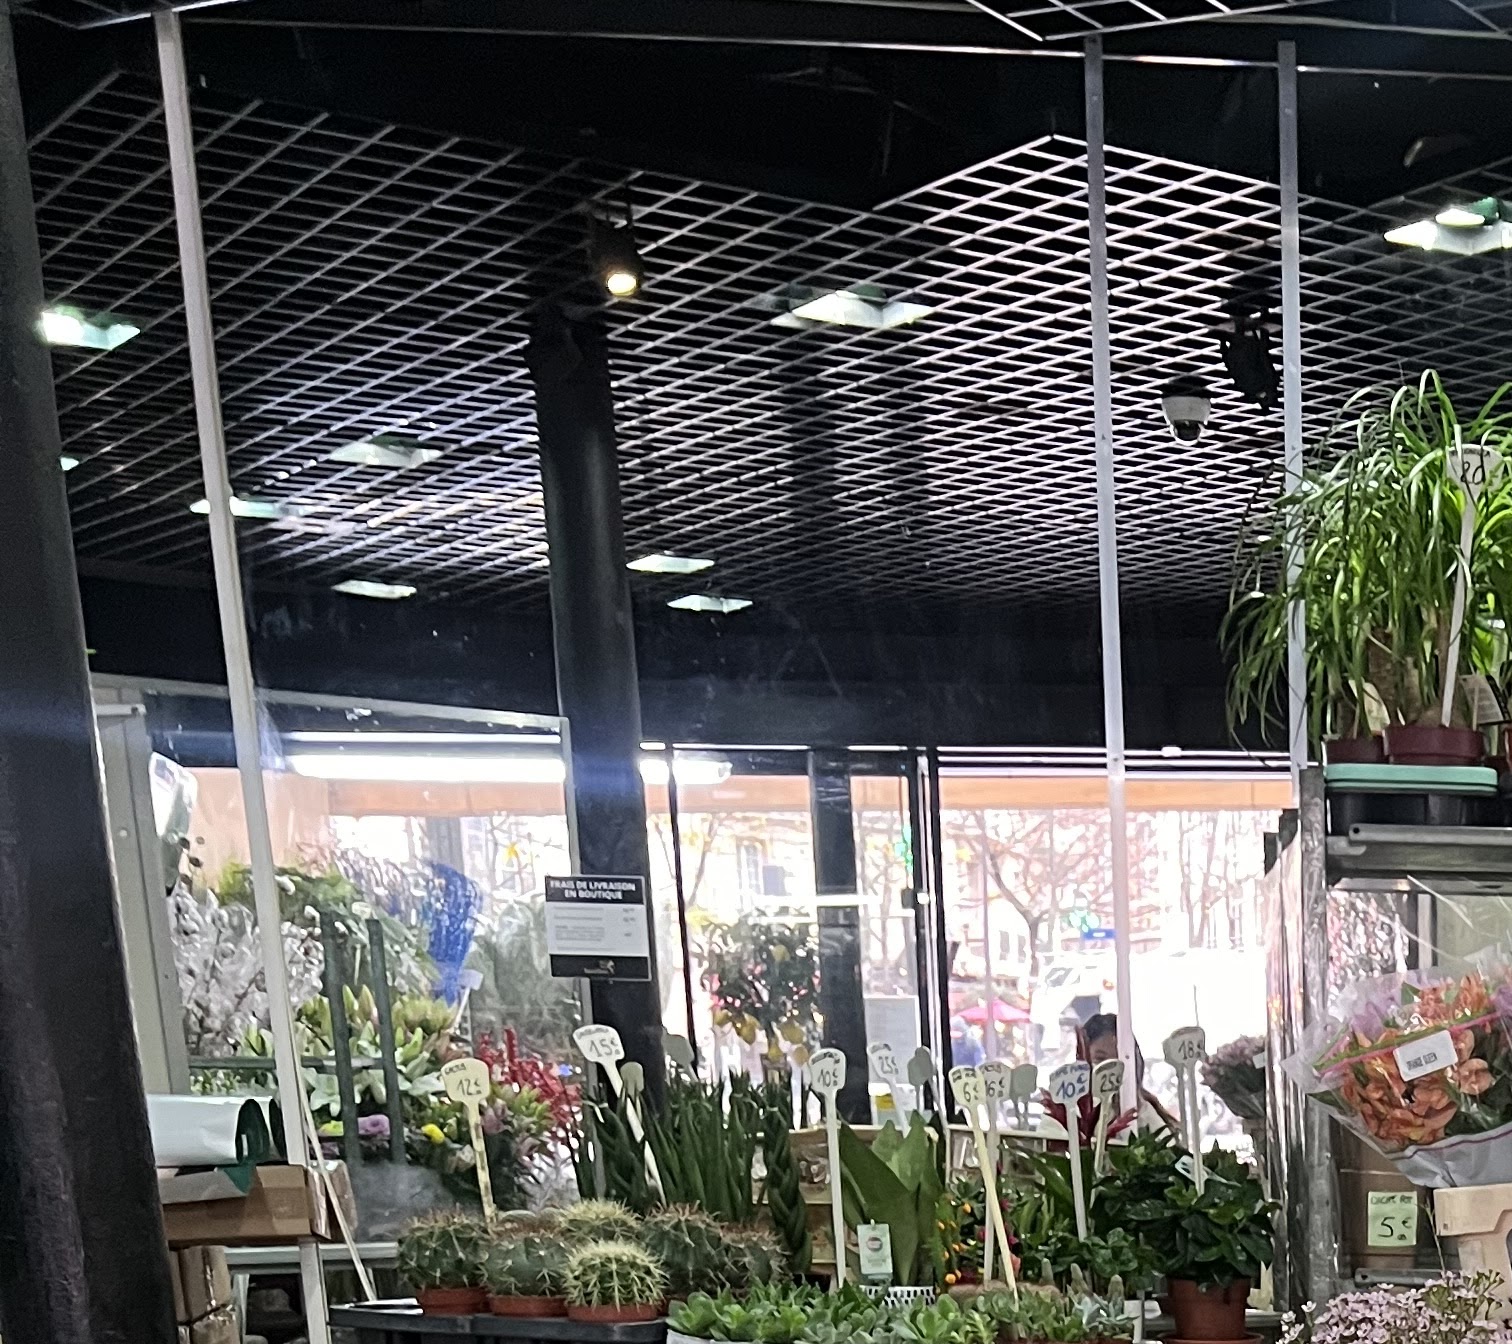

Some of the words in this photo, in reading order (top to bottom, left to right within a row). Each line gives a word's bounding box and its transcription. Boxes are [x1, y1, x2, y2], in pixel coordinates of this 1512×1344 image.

[564, 890, 577, 898] EN
[578, 890, 623, 899] BOUTIQUE
[576, 881, 588, 889] DE
[589, 1039, 612, 1058] 15
[1178, 1041, 1194, 1060] 18
[878, 1056, 893, 1075] 25
[457, 1078, 473, 1096] 12
[818, 1069, 831, 1087] 10
[1101, 1072, 1116, 1092] 25
[963, 1082, 971, 1102] 6
[1056, 1080, 1075, 1099] 10
[1378, 1217, 1394, 1237] 5
